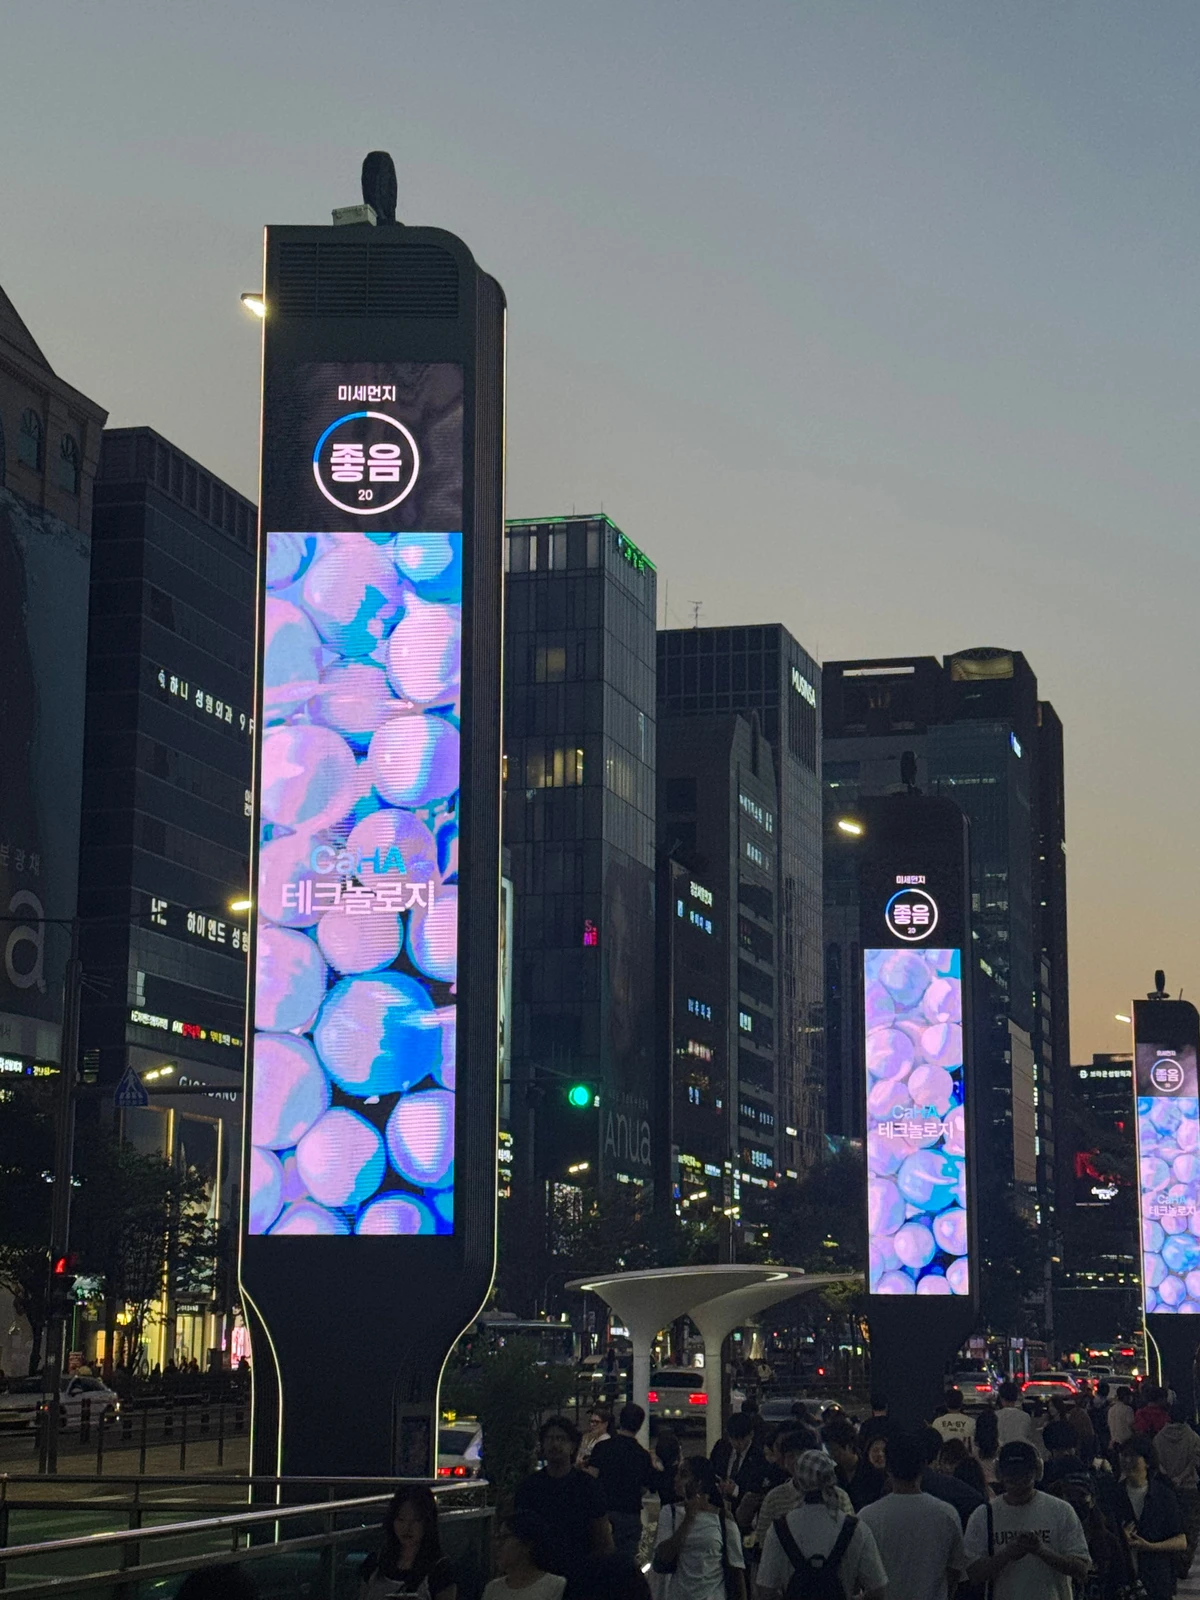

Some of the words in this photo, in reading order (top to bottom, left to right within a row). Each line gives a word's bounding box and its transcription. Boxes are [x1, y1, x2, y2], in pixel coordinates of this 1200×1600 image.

[338, 385, 396, 402] 미세먼지
[330, 443, 402, 482] 좋음
[358, 489, 373, 501] 20
[170, 675, 188, 700] 하니
[195, 689, 232, 724] 성형외과
[310, 845, 406, 874] CaHA
[895, 875, 926, 885] 미세먼지
[281, 879, 435, 915] 테크놀로지
[893, 904, 930, 925] 좋음
[187, 911, 226, 944] 하이엔드
[892, 1104, 940, 1120] CaHA
[604, 1110, 652, 1166] Anua
[877, 1121, 953, 1140] 테크놀로지
